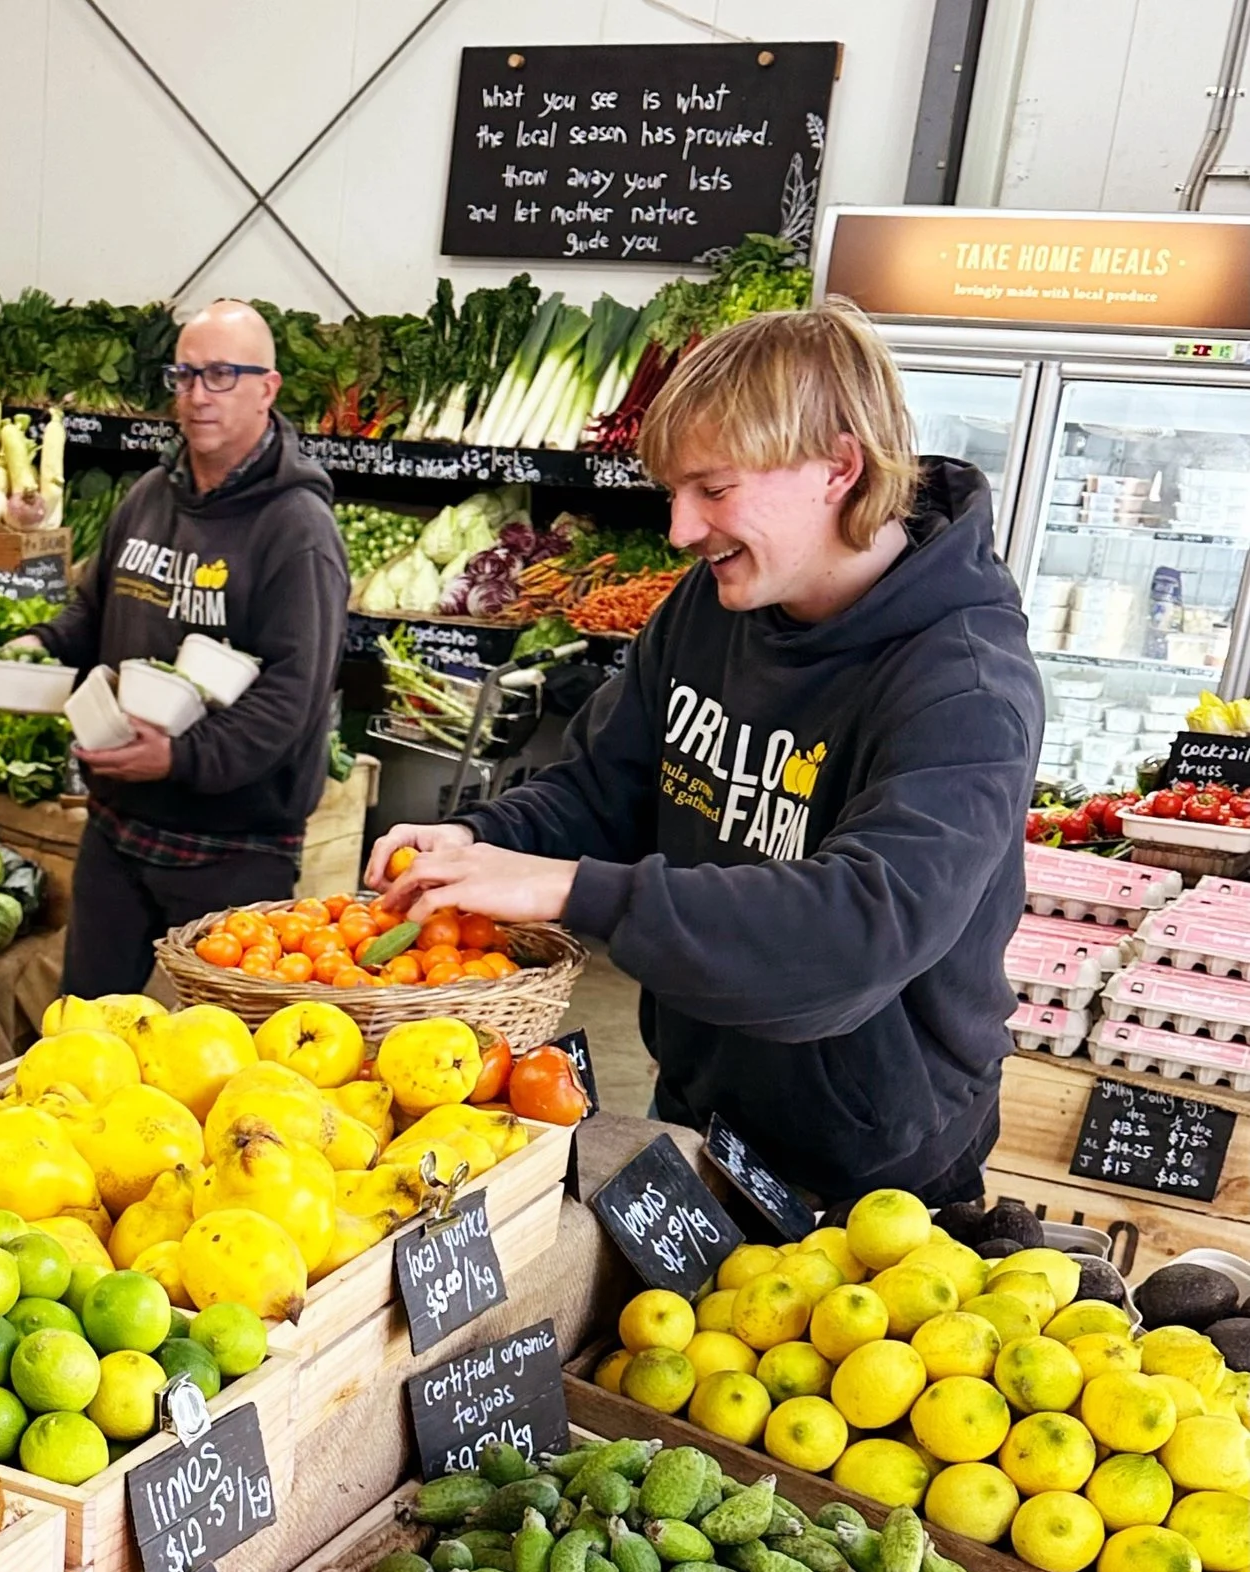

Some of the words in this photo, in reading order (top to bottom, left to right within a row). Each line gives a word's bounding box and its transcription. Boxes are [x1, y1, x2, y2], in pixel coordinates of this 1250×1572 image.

[482, 84, 525, 109] what
[538, 92, 575, 117] you
[591, 89, 618, 110] see
[643, 90, 661, 110] is
[677, 83, 730, 113] what
[476, 124, 504, 148] the
[516, 121, 557, 148] local
[569, 125, 627, 145] season
[641, 122, 676, 147] has
[684, 121, 773, 160] provided.
[502, 164, 547, 187] throw
[567, 168, 614, 198] away
[623, 171, 667, 198] your
[690, 165, 732, 192] lists
[467, 204, 497, 223] and
[514, 200, 541, 223] let
[551, 201, 613, 224] mother
[631, 198, 699, 226] nature
[563, 230, 609, 256] guide
[956, 243, 1012, 271] TAKE
[1017, 244, 1085, 273] HOME
[1089, 247, 1171, 276] MEALS
[954, 282, 1004, 300] lovingly
[1006, 286, 1039, 298] made
[1042, 287, 1070, 299] with
[1073, 288, 1104, 300] local
[1106, 289, 1158, 304] produce
[491, 447, 533, 473] leeks
[117, 538, 199, 587] TORELLO
[167, 586, 226, 626] FARM
[1177, 760, 1223, 777] truss
[1181, 743, 1250, 763] cocktail
[718, 784, 810, 861] FARM
[610, 1182, 667, 1245] lemons
[406, 1237, 442, 1287] local
[442, 1207, 489, 1269] quince
[424, 1354, 495, 1406] certified
[501, 1331, 555, 1376] organic
[453, 1384, 515, 1434] feijoas
[147, 1442, 222, 1531] limes
